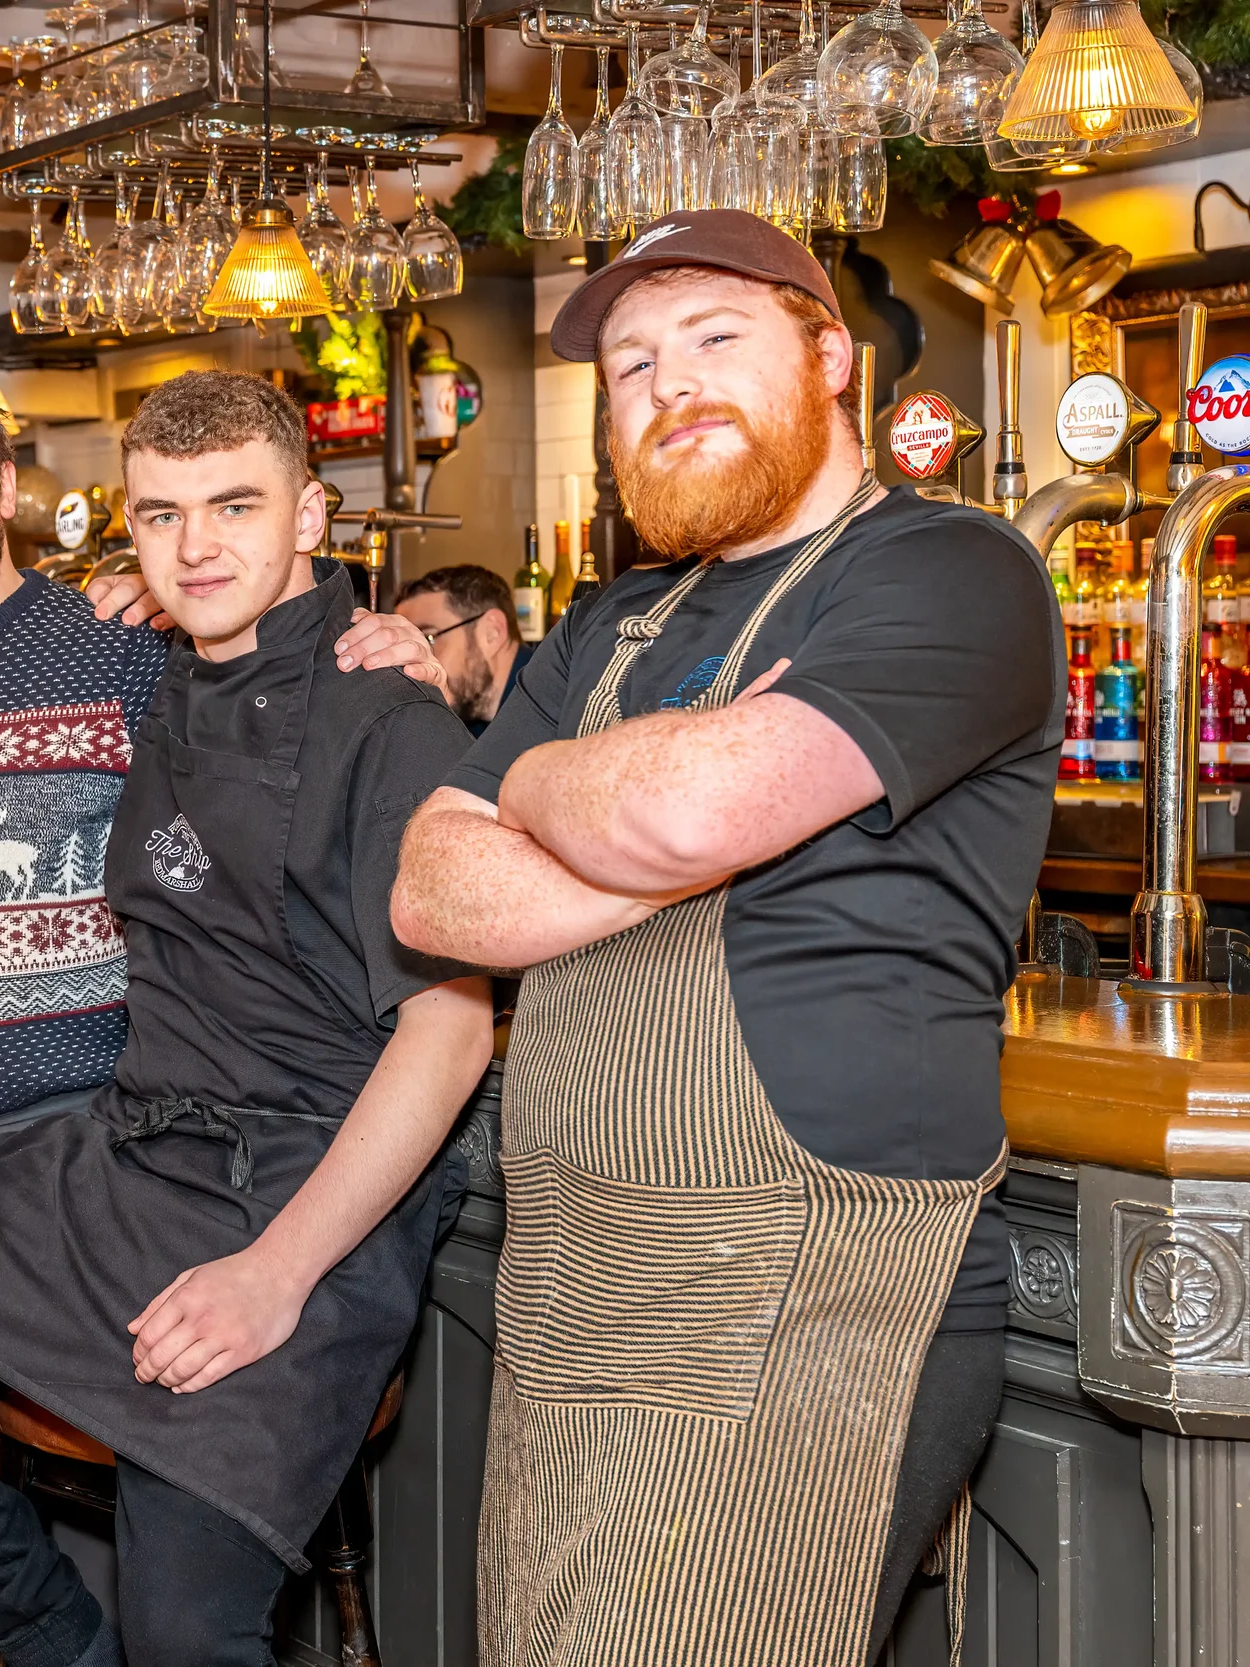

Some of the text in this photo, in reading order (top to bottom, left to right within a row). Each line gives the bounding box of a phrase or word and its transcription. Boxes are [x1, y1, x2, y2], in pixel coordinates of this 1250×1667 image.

[1186, 385, 1250, 424] Coor
[891, 427, 948, 445] Cruzcampo
[1072, 427, 1098, 436] DRAUGHT
[1205, 433, 1218, 444] COLD
[1239, 435, 1250, 445] ROC
[57, 518, 85, 534] ARLING
[145, 830, 182, 858] The
[183, 843, 211, 875] Ship
